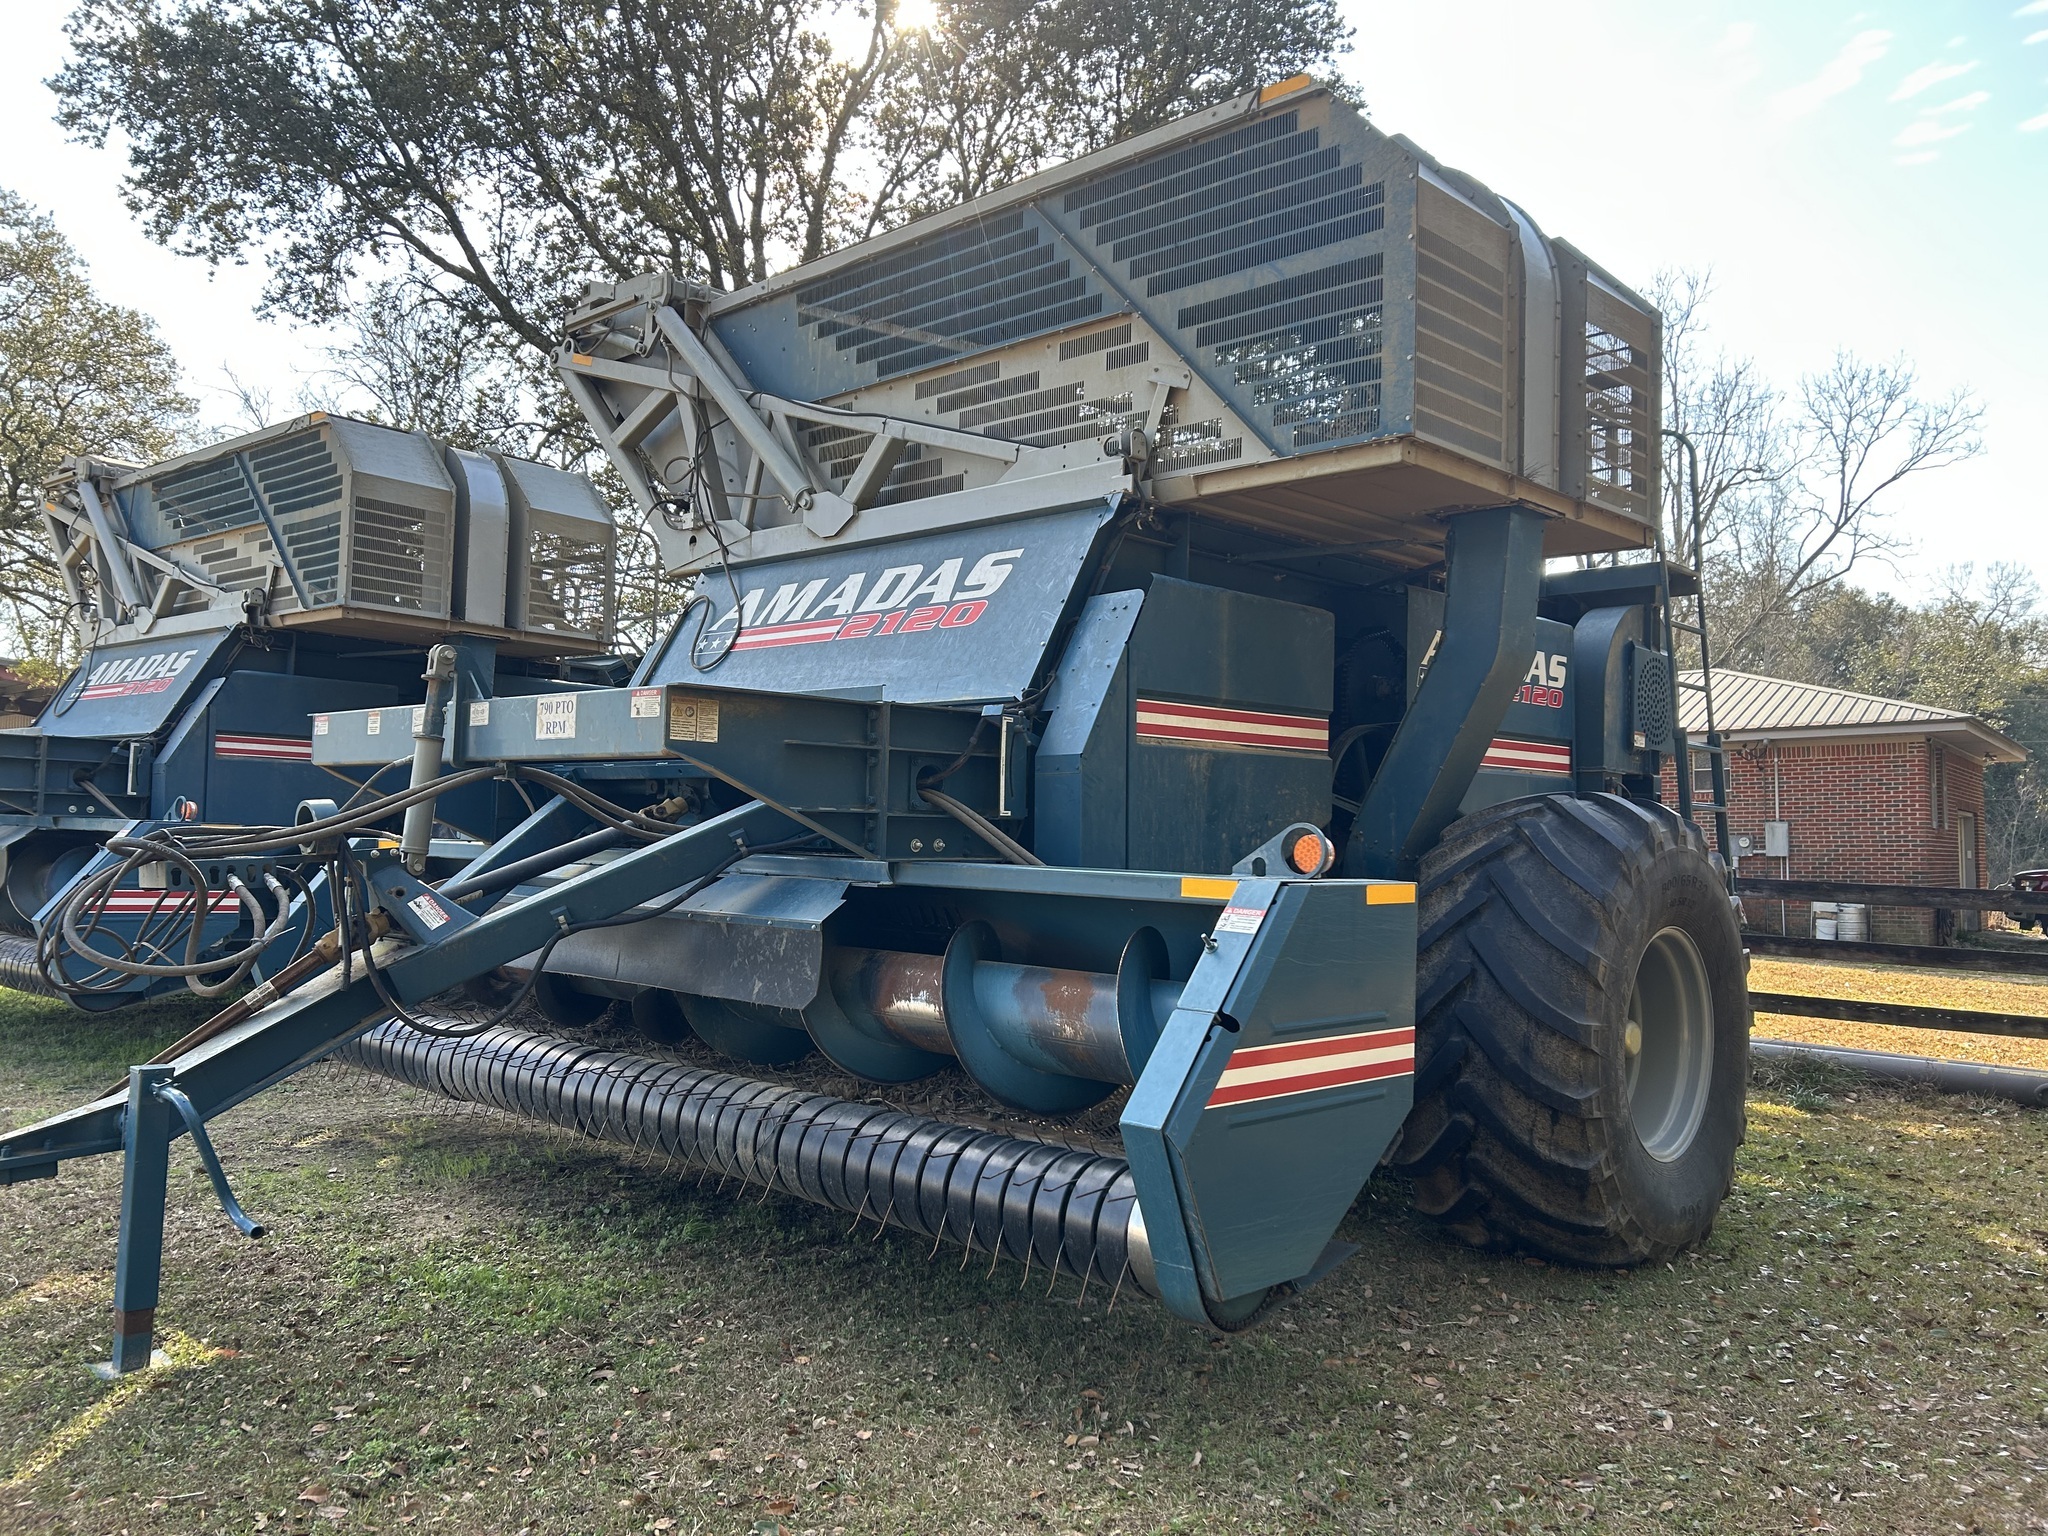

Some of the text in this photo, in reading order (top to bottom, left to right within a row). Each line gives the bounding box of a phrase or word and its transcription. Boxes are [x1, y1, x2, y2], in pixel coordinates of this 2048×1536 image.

[710, 548, 1024, 631] AMADAS
[836, 600, 989, 640] 2120
[78, 649, 199, 687] AMADAS
[119, 676, 175, 696] 2120
[540, 700, 574, 715] 790 PTO
[545, 720, 566, 734] RPM
[1232, 907, 1263, 916] DANGER
